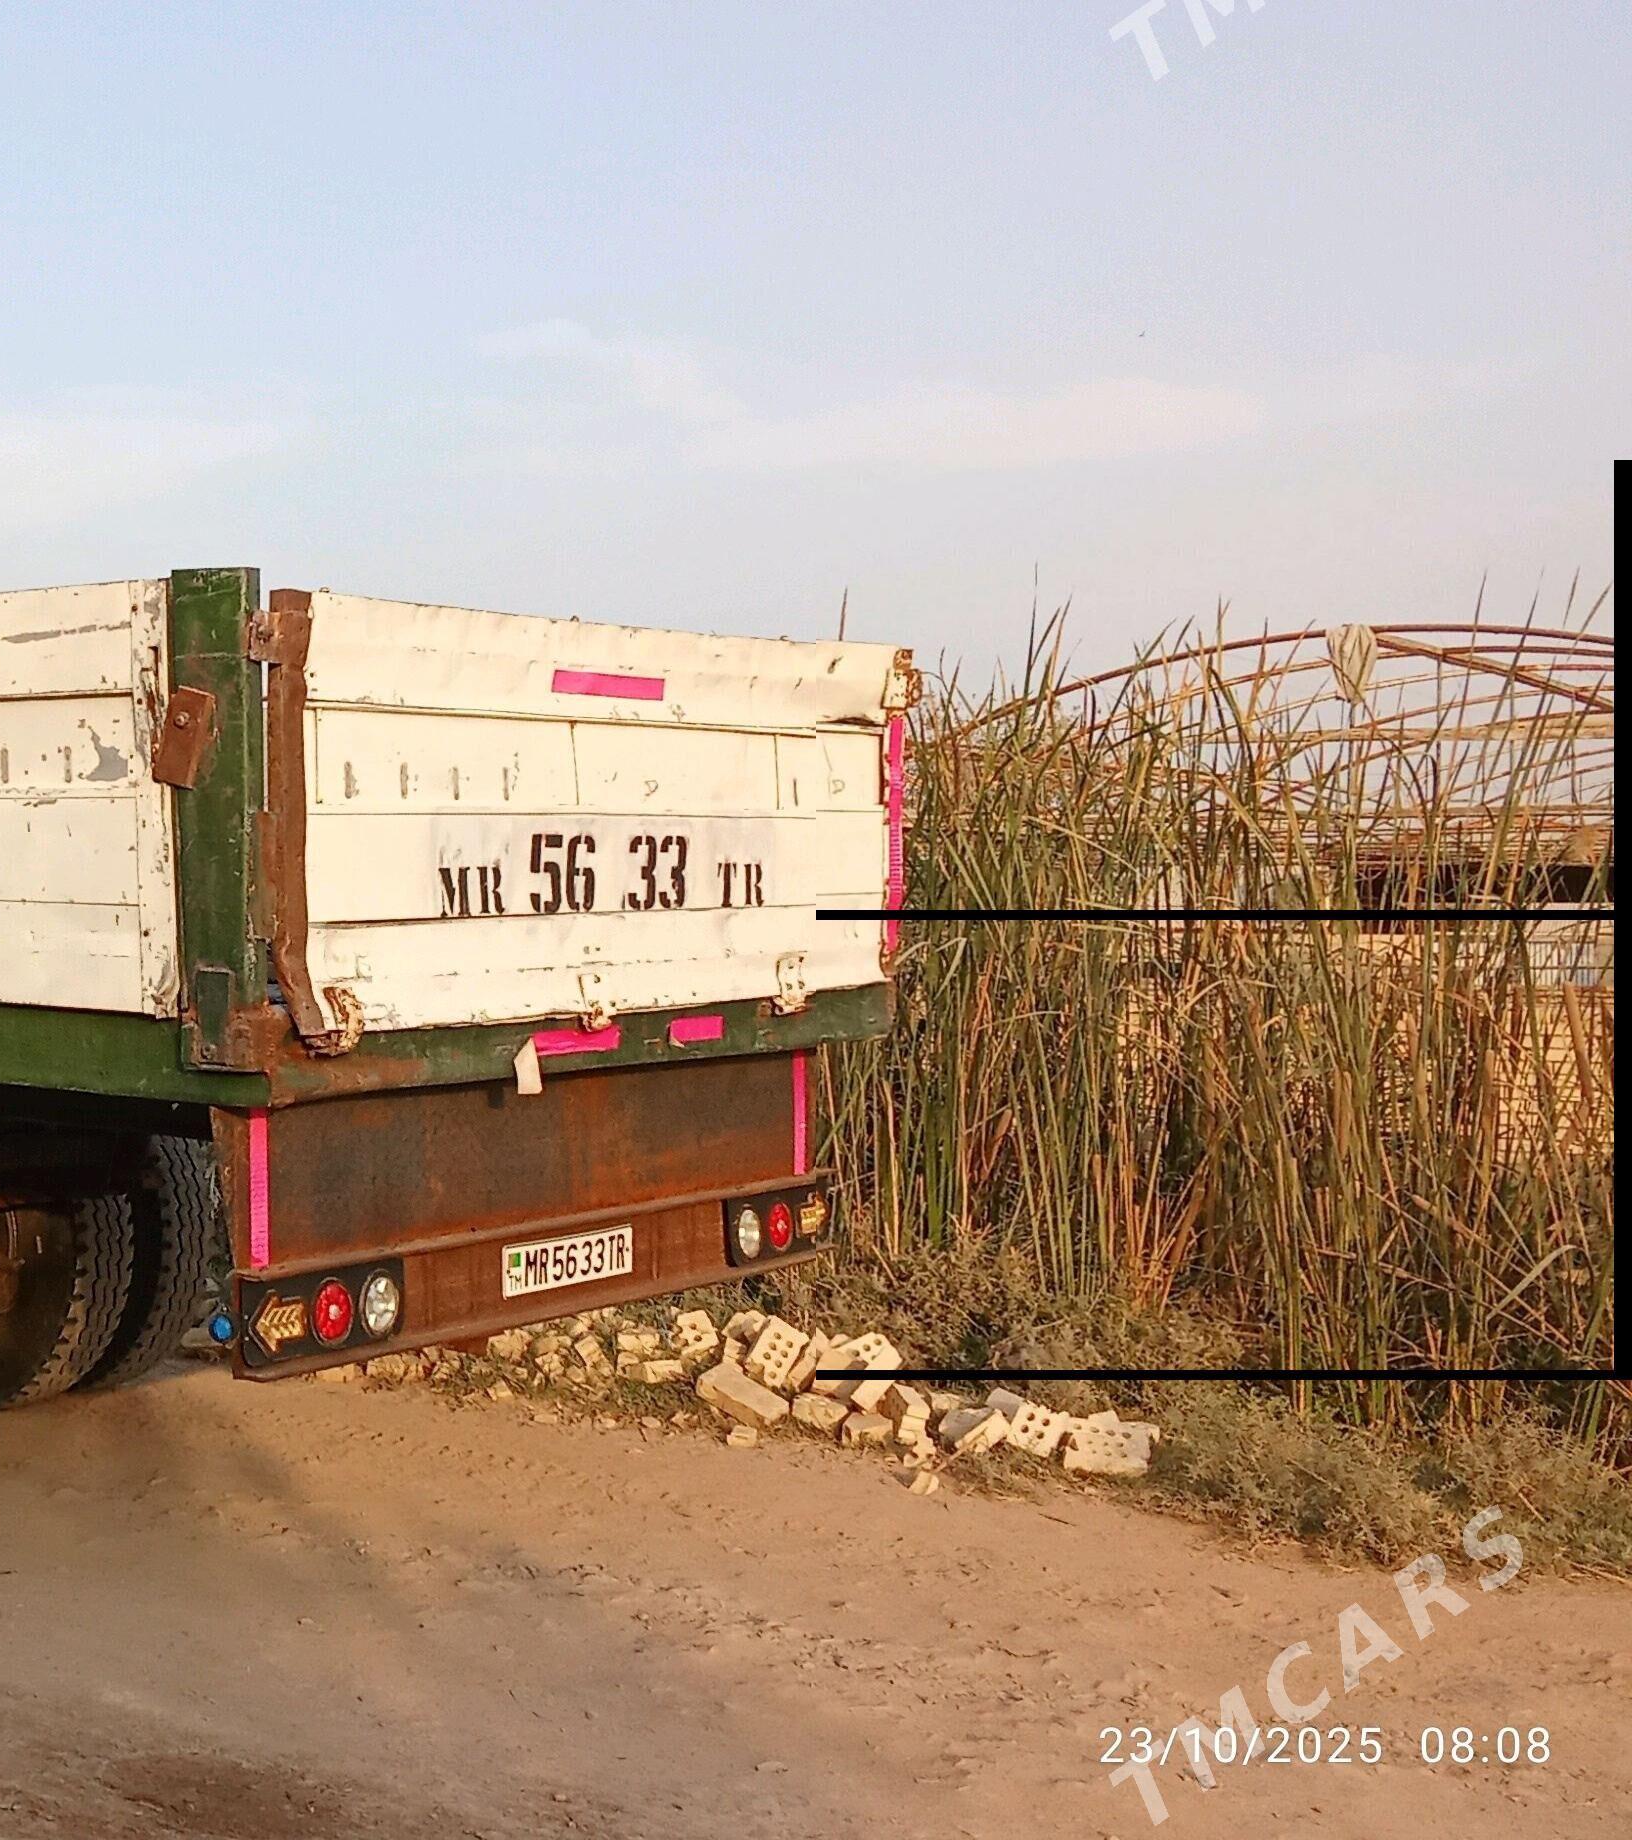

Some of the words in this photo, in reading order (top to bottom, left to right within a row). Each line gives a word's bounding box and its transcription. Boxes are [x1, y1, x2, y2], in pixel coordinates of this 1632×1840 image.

[438, 866, 506, 918] MR
[530, 833, 597, 914] 56
[626, 834, 689, 911] 33
[717, 862, 765, 908] TR
[508, 1274, 523, 1291] TM
[524, 1233, 626, 1287] MR5633TR
